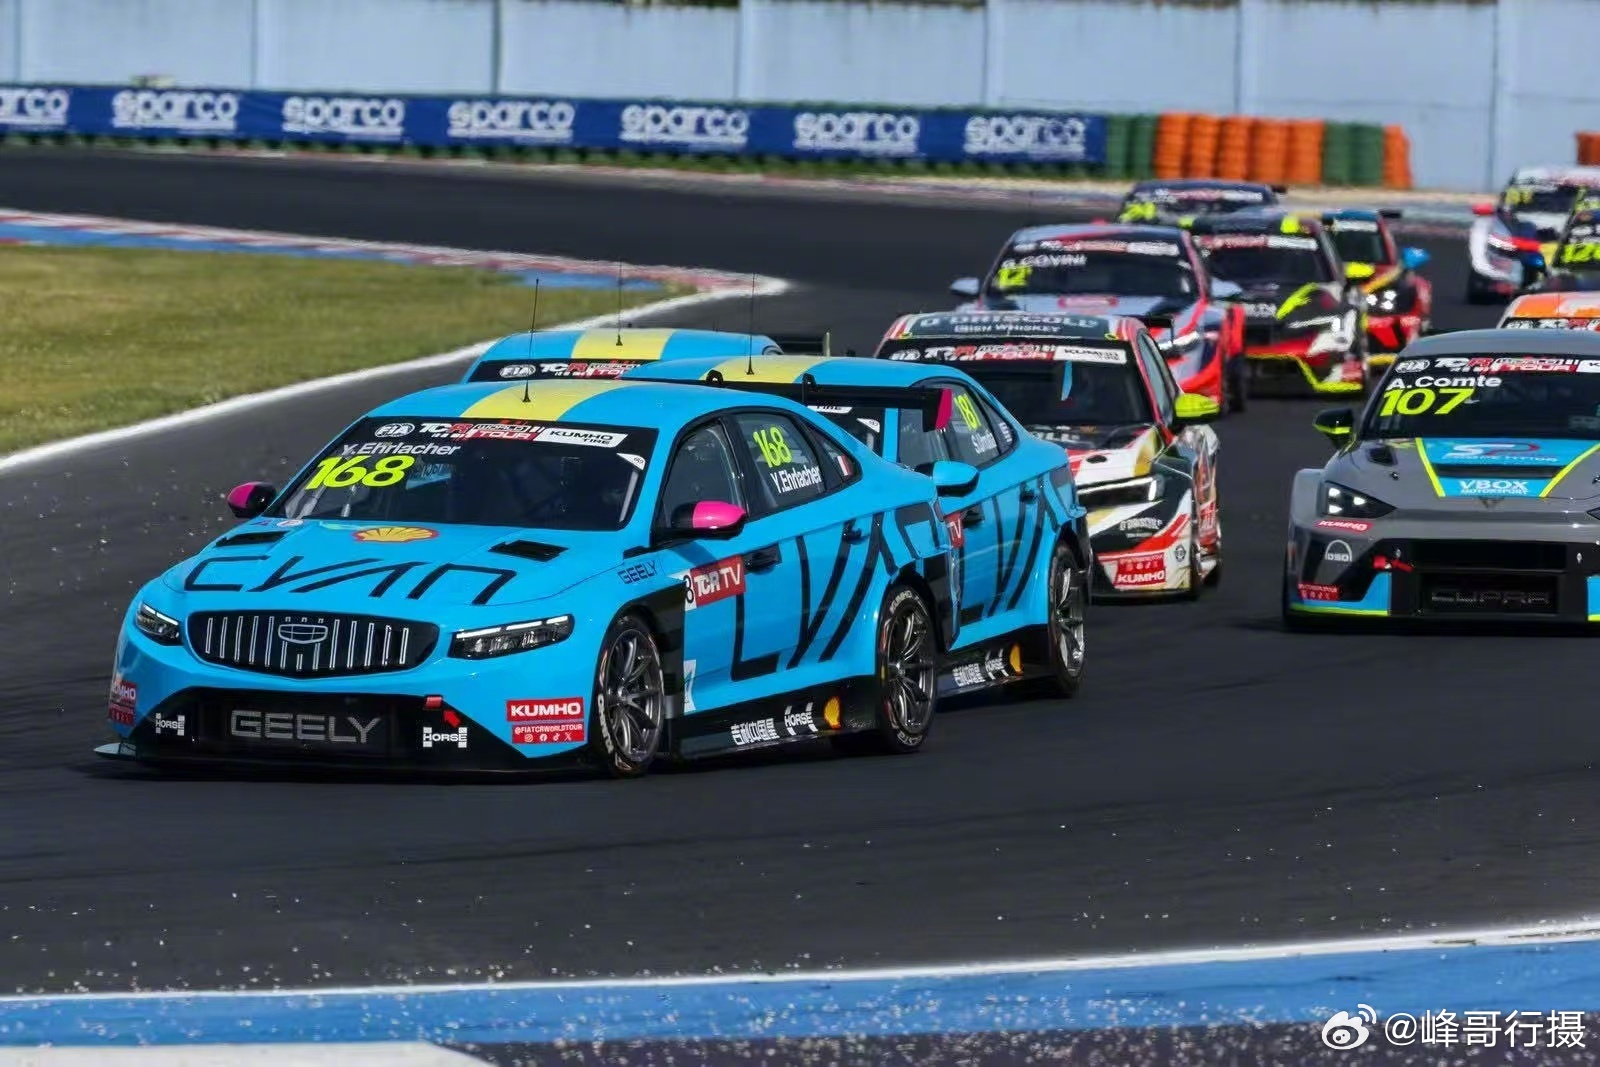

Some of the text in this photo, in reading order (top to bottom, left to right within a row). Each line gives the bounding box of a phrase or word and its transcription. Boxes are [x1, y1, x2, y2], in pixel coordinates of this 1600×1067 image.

[112, 90, 238, 123] sparco
[282, 97, 405, 127] sparco
[447, 101, 575, 130] sparco
[621, 104, 748, 136] sparco
[795, 111, 919, 143] sparco
[964, 116, 1085, 147] sparco
[500, 364, 536, 378] FIA
[1387, 375, 1502, 390] A.Comte
[1380, 387, 1475, 416] 107
[374, 422, 415, 438] FIA
[418, 422, 473, 433] TCR
[479, 430, 532, 441] TOUR
[549, 430, 614, 442] KUMHO
[752, 426, 793, 468] 168
[305, 454, 416, 490] 168
[770, 464, 823, 494] Y.Ehrlacher
[1459, 480, 1529, 490] VBOX
[617, 560, 657, 585] GEELY
[719, 563, 741, 589] TV
[1117, 570, 1166, 583] KUMHO
[511, 702, 581, 717] KUMHO
[231, 710, 380, 744] GEELY
[423, 730, 468, 745] HORSE
